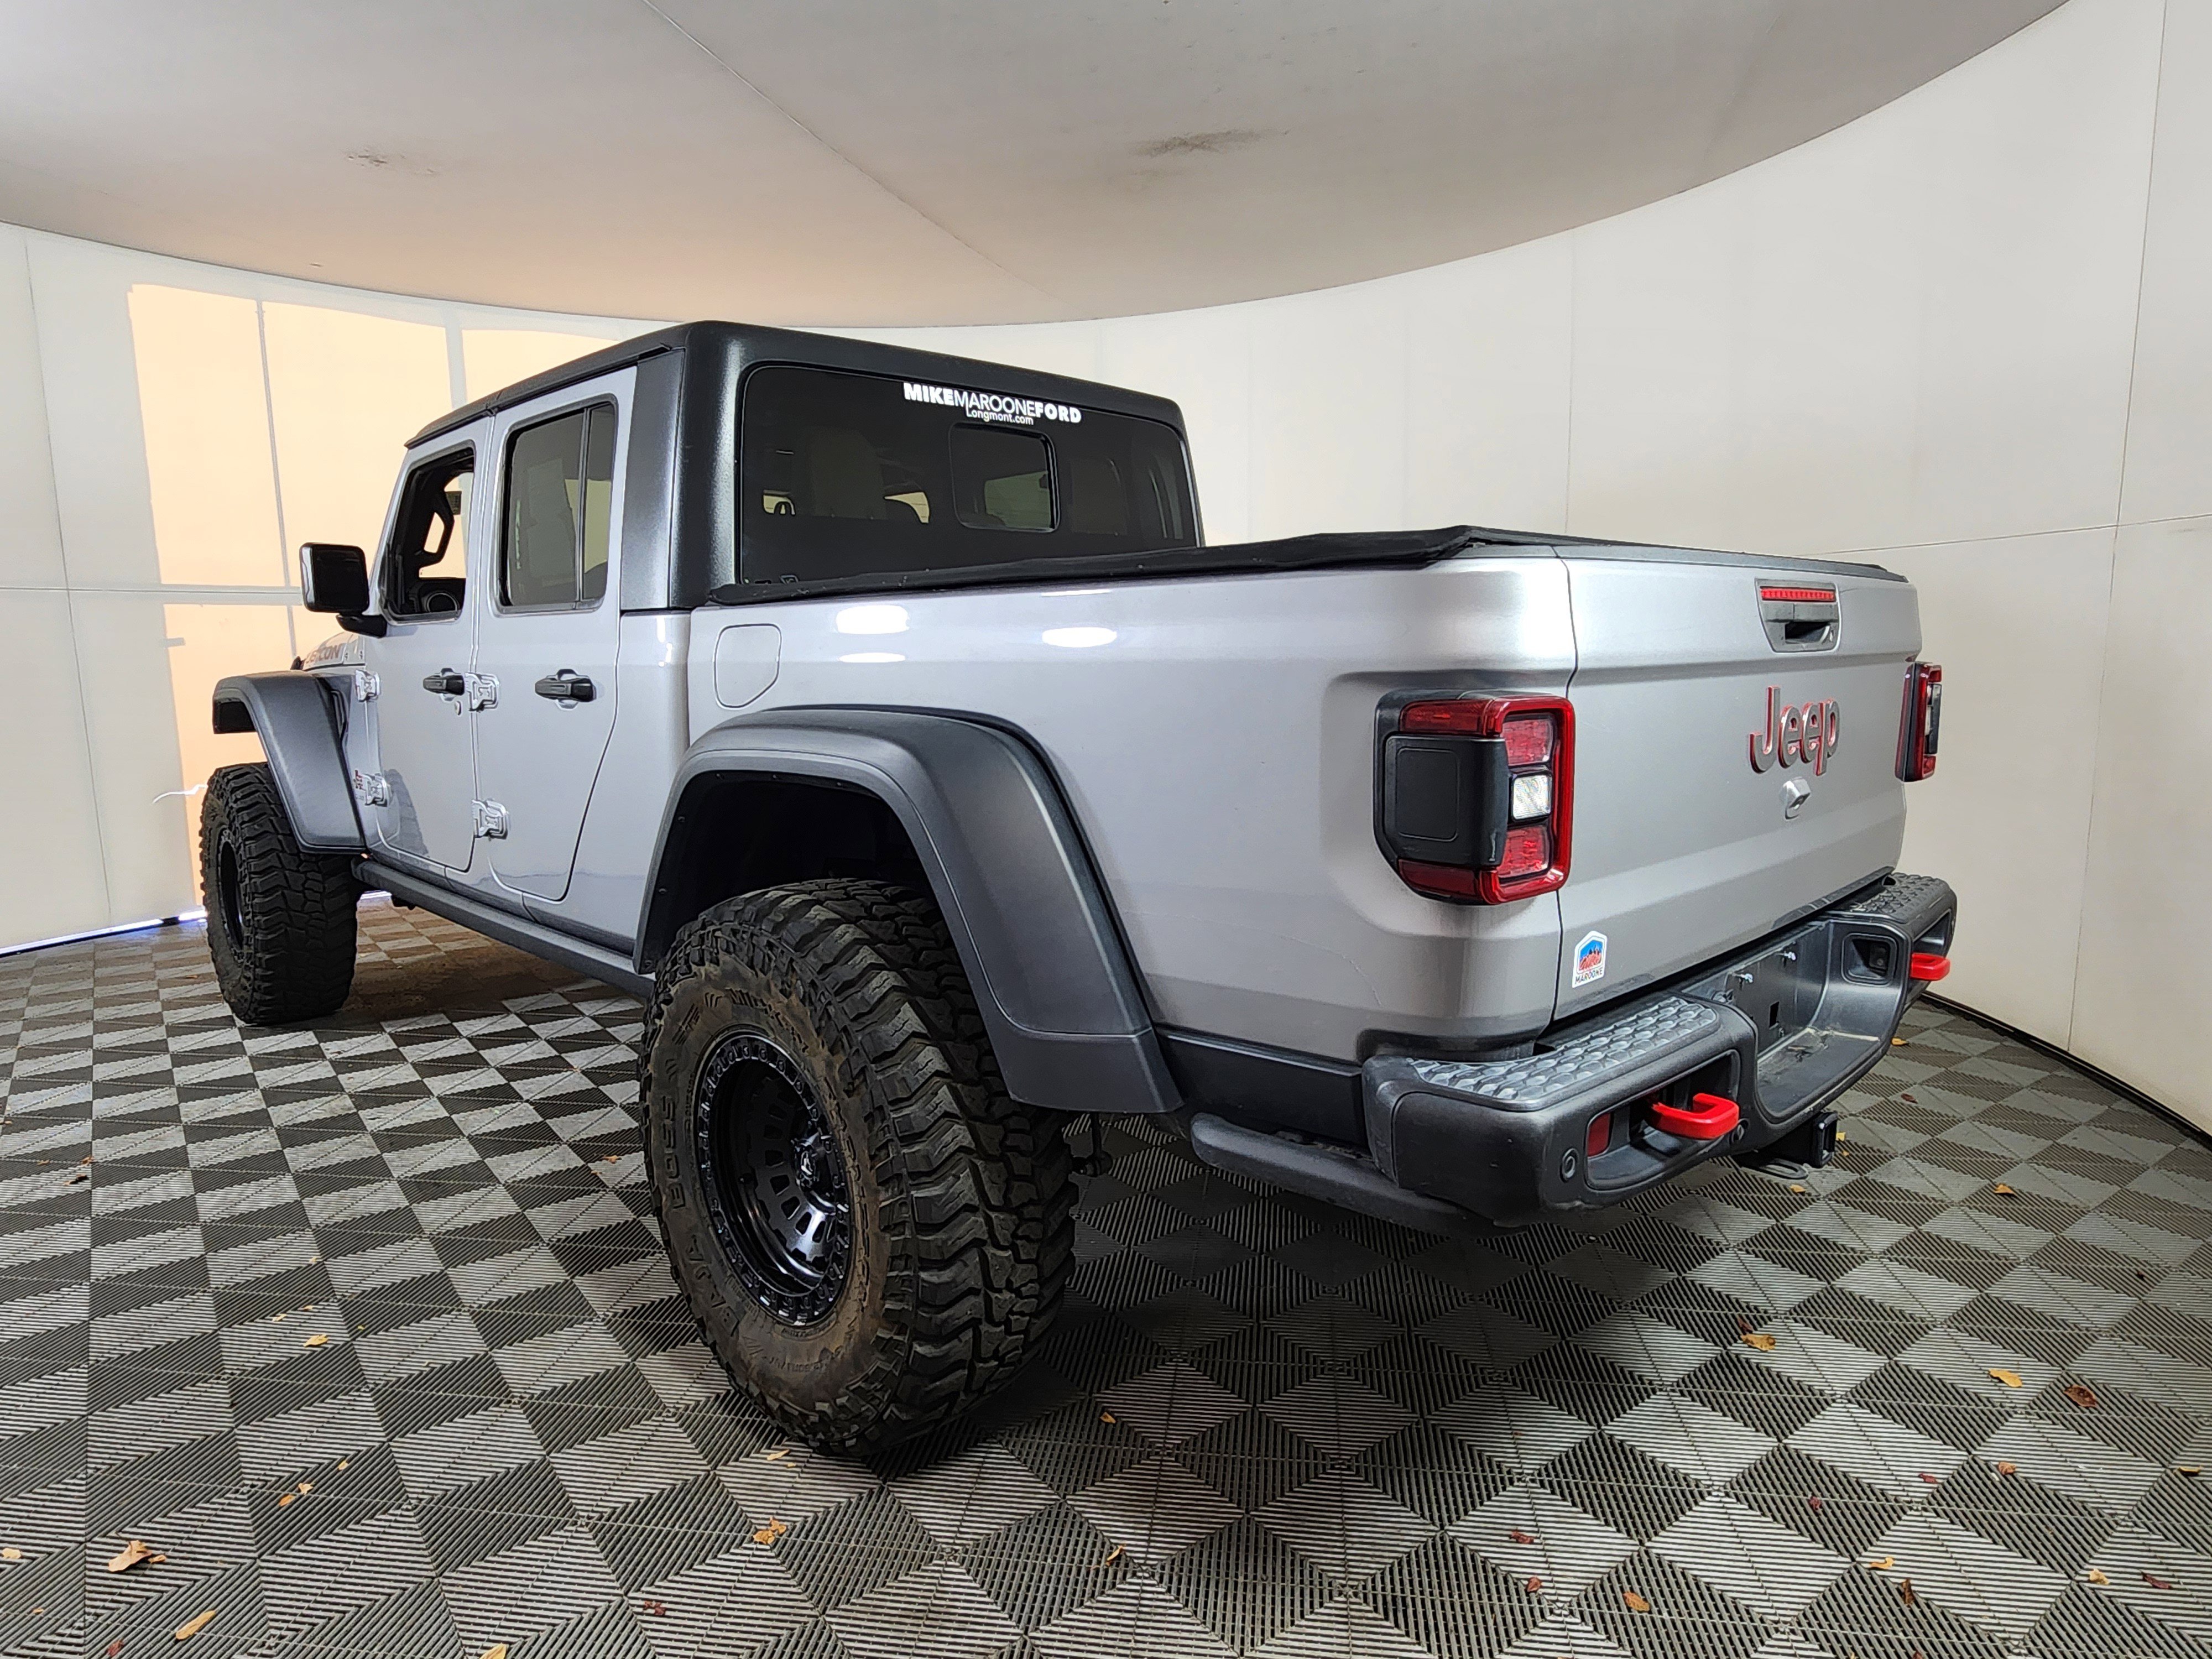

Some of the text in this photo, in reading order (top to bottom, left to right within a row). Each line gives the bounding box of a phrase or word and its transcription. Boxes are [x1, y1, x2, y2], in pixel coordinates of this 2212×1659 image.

[966, 406, 1034, 425] Longmont.com
[1749, 685, 1840, 776] Jeep
[1574, 967, 1603, 985] MAROONE
